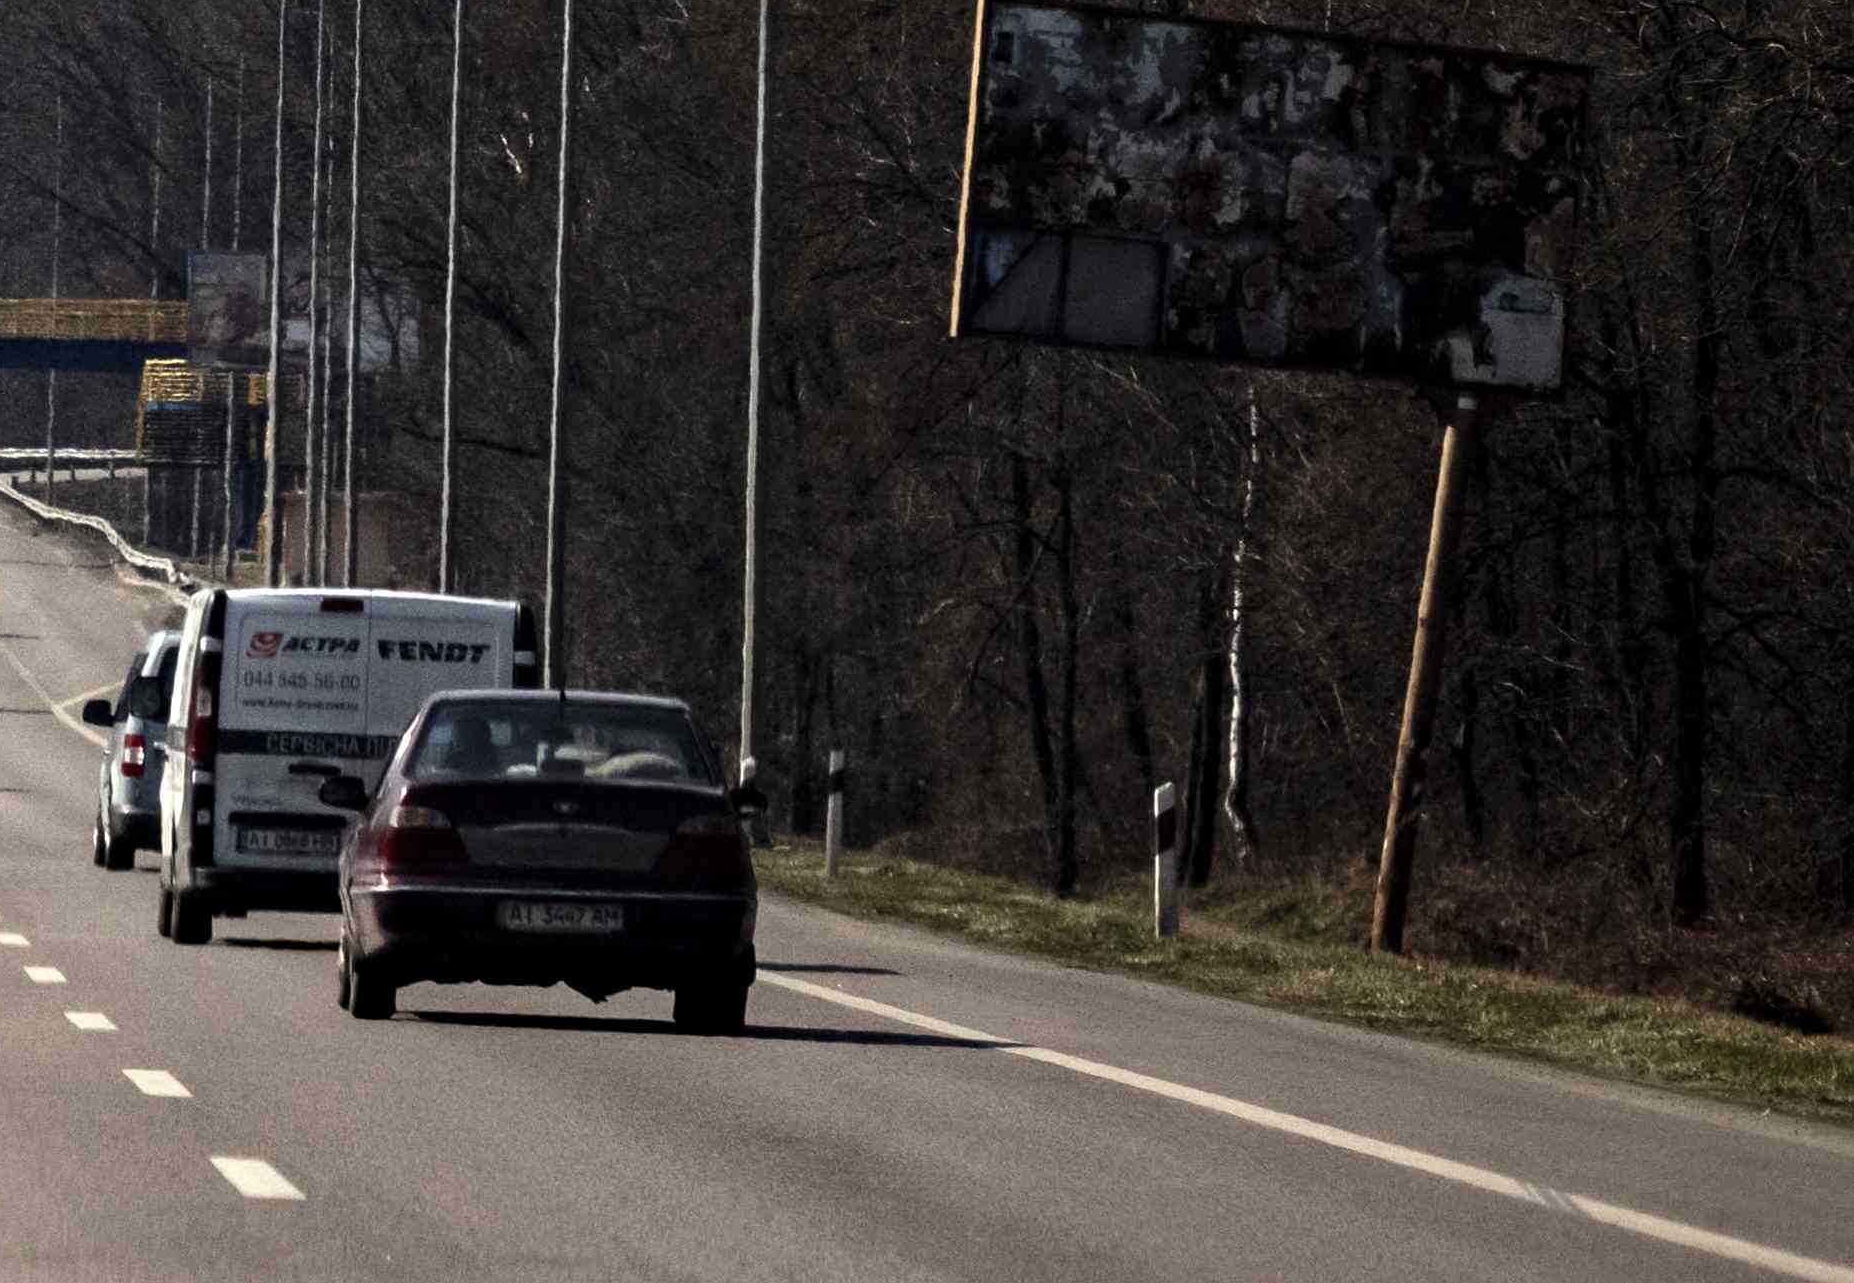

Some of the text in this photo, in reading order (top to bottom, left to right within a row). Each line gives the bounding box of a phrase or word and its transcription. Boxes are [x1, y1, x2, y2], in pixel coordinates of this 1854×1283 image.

[282, 635, 361, 654] АСТРА
[377, 638, 491, 665] FENDT
[243, 669, 274, 687] 044
[266, 733, 360, 758] СЕРВІСНА
